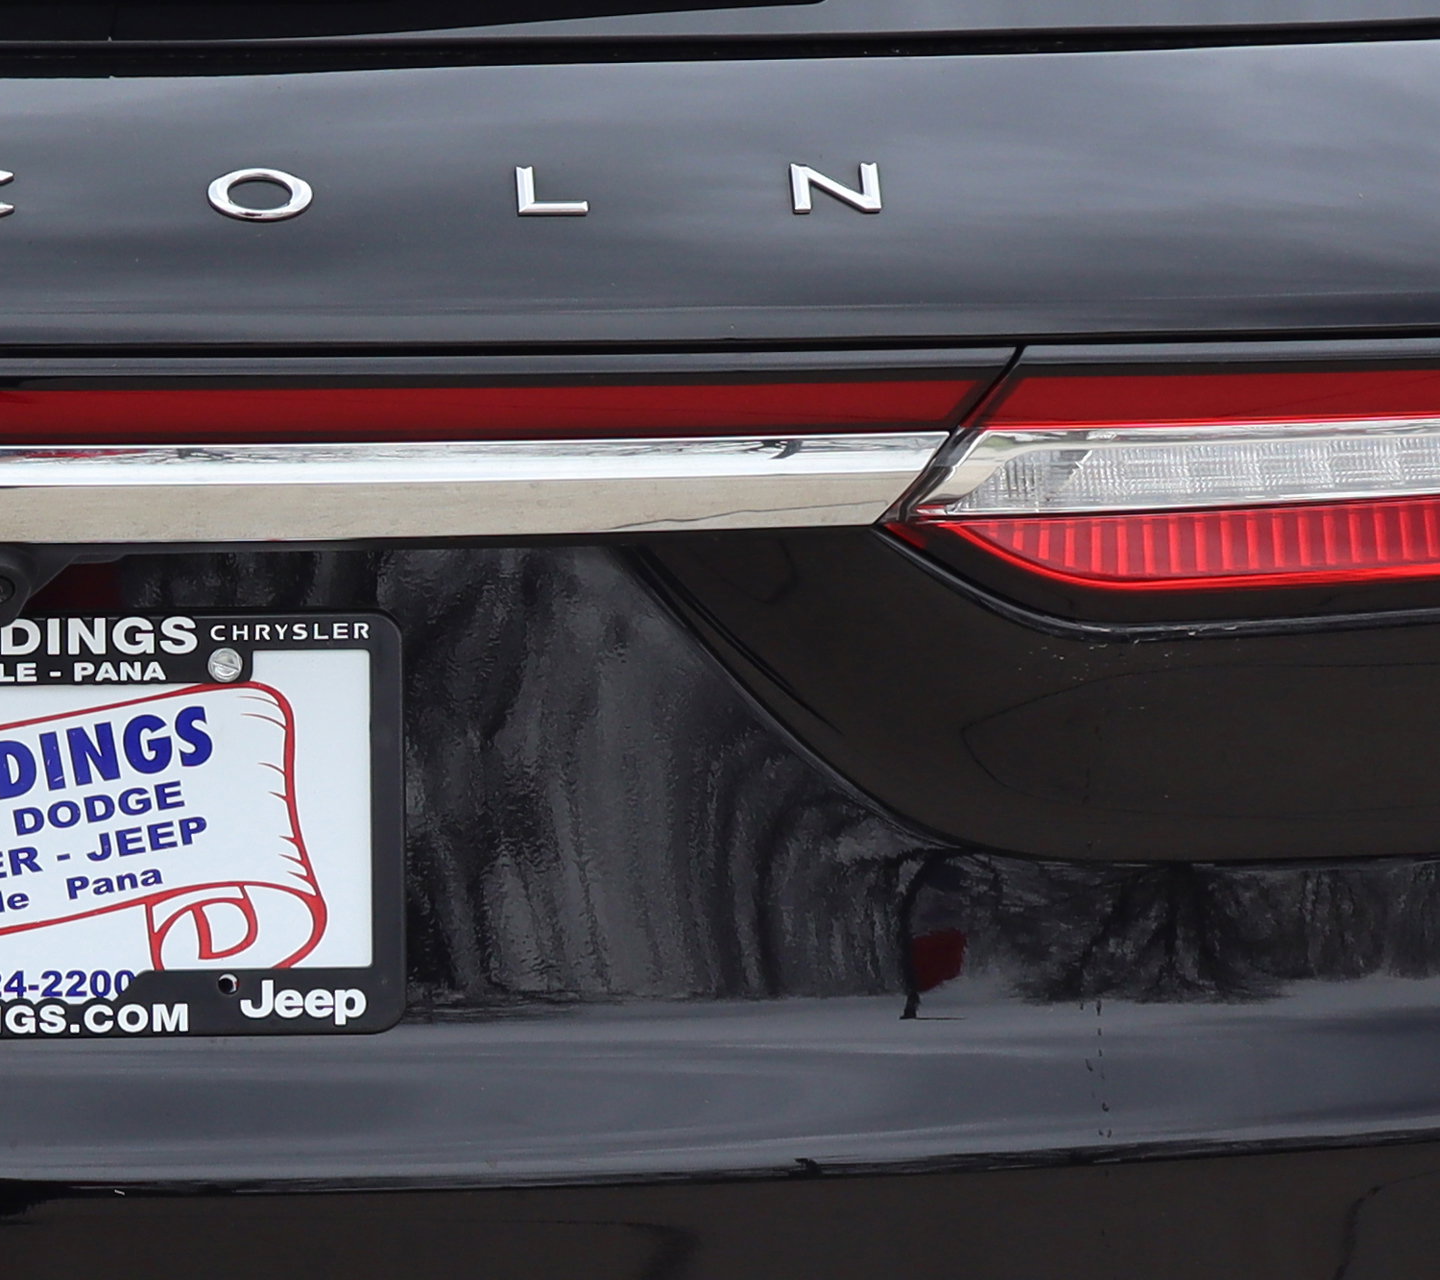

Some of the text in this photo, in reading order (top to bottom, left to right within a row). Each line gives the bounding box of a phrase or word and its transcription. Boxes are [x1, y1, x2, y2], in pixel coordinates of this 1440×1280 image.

[209, 623, 370, 642] CHRYSLER
[73, 661, 167, 682] PANA
[12, 780, 186, 837] DODGE
[85, 815, 208, 862] JEEP
[65, 868, 164, 900] Pana
[239, 979, 367, 1026] Jeep
